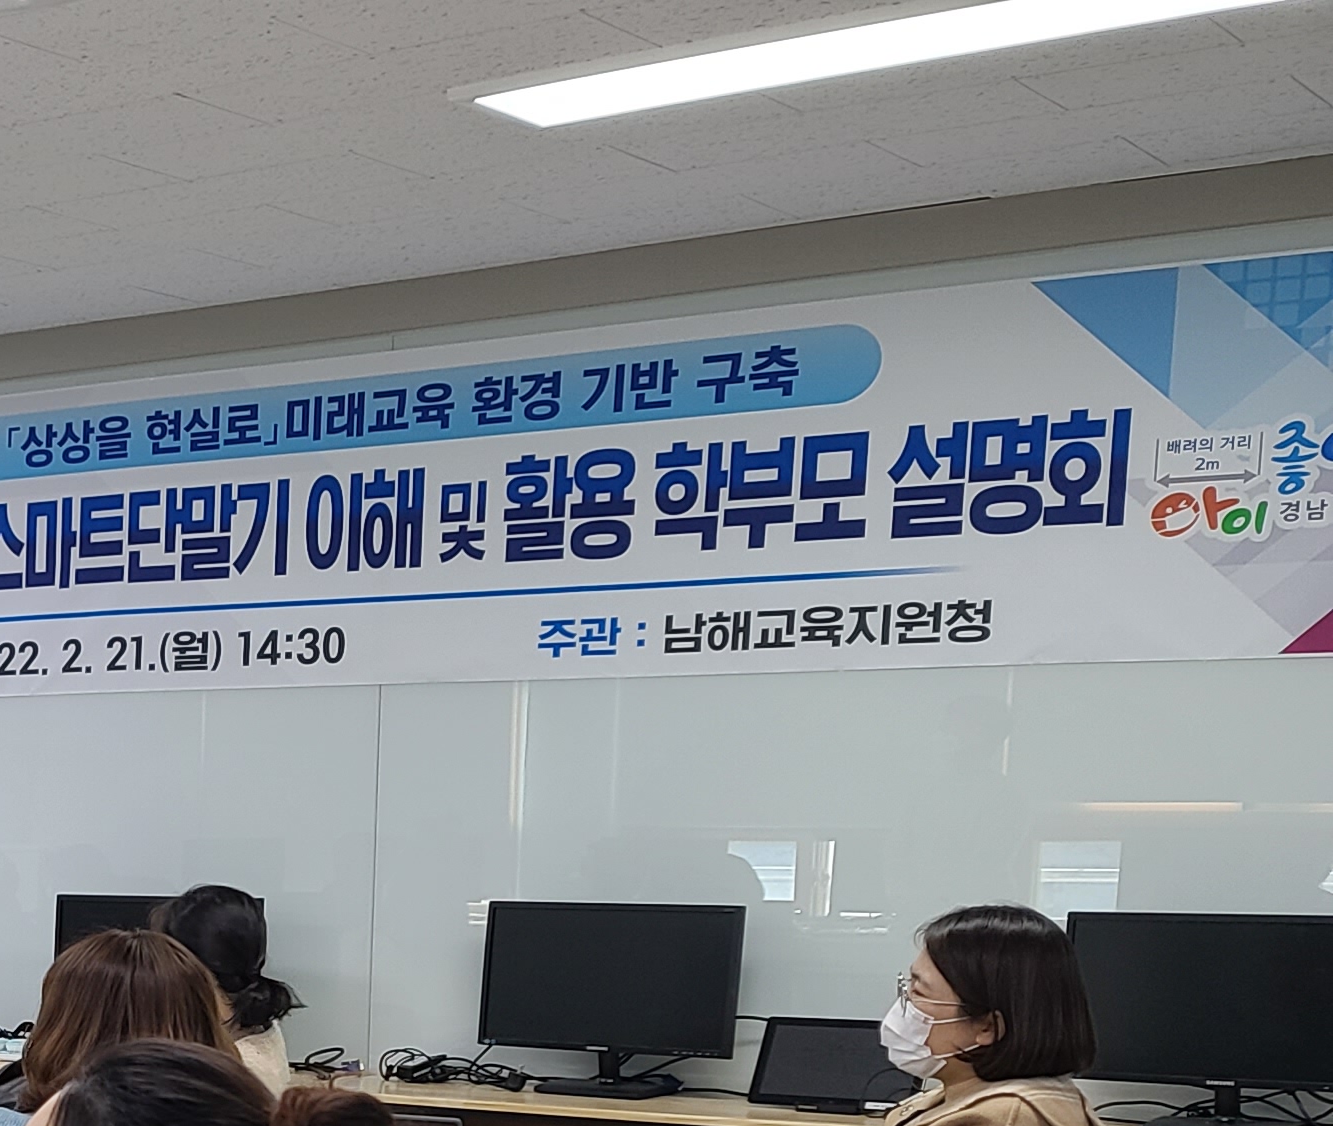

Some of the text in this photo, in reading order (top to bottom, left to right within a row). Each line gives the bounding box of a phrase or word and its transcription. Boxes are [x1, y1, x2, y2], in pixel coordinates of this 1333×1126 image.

[472, 371, 562, 426] 환경
[581, 359, 679, 413] 기반
[696, 345, 799, 404] 구축
[1166, 435, 1252, 454] 배려의 거리
[1194, 458, 1220, 471] 2m
[305, 467, 426, 572] 이해
[439, 480, 487, 563] 및
[504, 448, 636, 563] 활용
[654, 431, 870, 551] 학부모
[887, 408, 1132, 539] 설명회
[1279, 499, 1328, 522] 경남
[61, 639, 91, 674] 2.
[106, 630, 222, 674] 21.(월)
[237, 626, 346, 667] 14:30
[537, 617, 621, 657] 주관
[663, 599, 993, 654] 남해교육지원청
